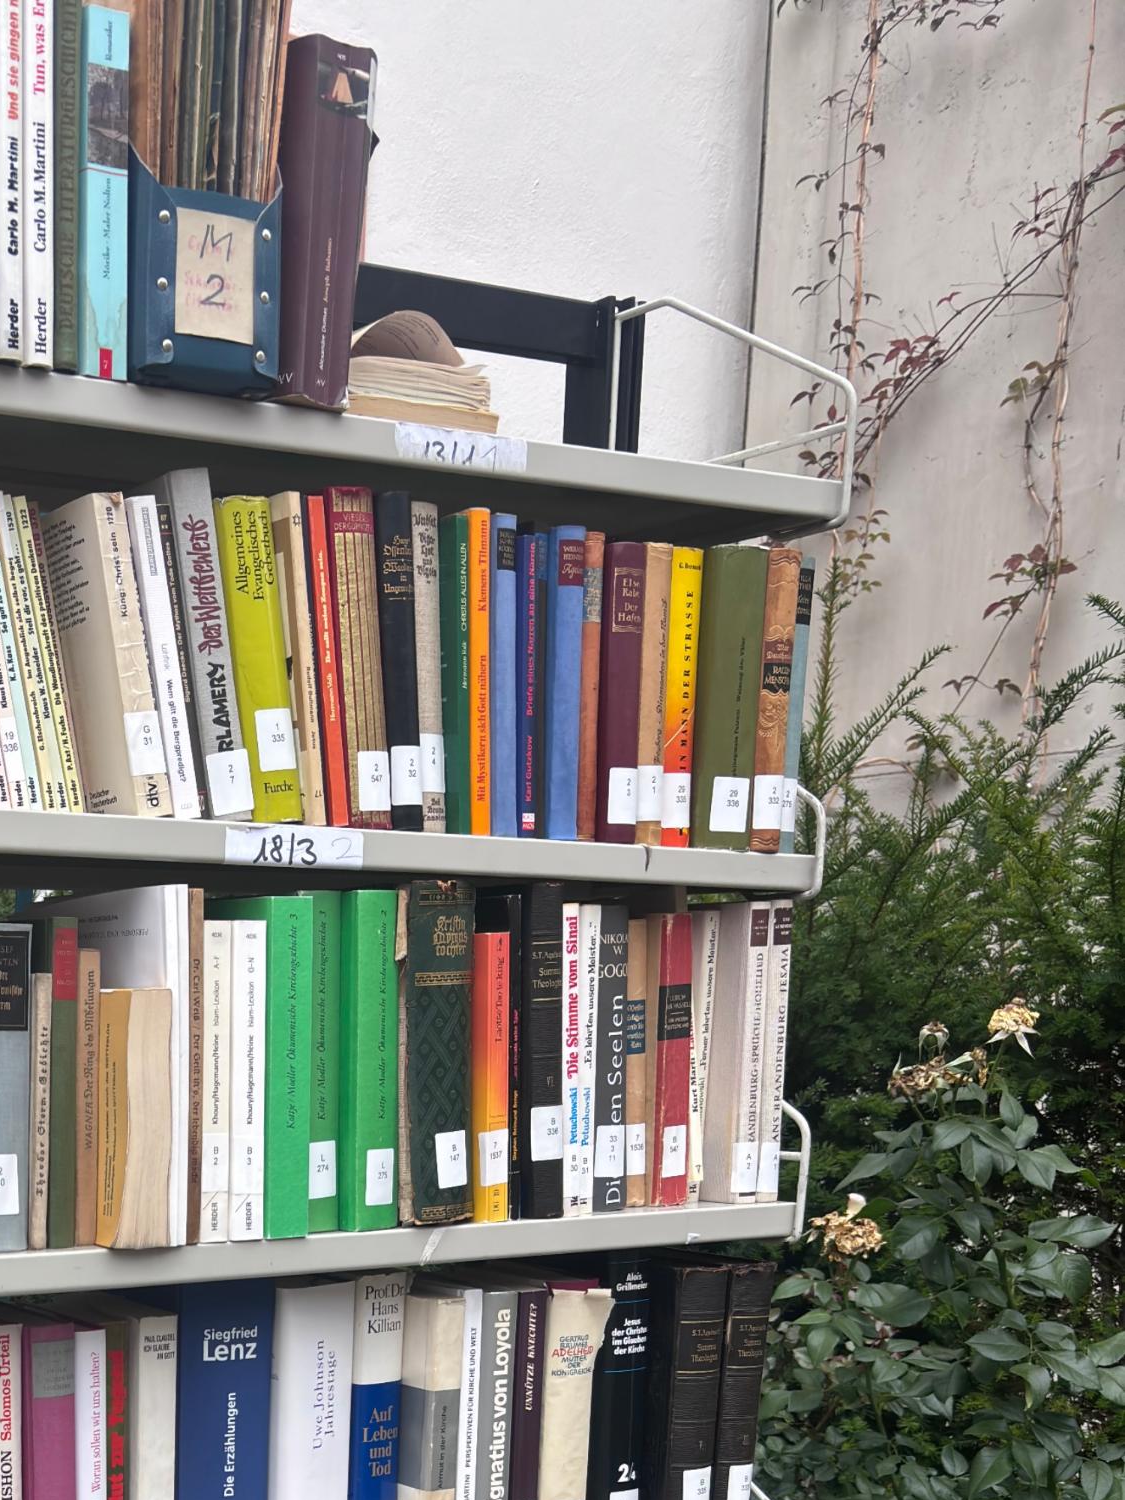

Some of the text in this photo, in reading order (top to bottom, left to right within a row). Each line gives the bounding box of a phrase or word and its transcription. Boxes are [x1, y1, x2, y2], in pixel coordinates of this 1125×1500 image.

[33, 24, 47, 354] Herder Carlo M. Martini Tun, was
[200, 275, 227, 308] 2
[231, 511, 249, 594] Allgemeines
[246, 511, 264, 600] Evangelisches
[259, 510, 275, 585] Gebetbuch
[477, 520, 488, 801] Mit Mystikern sich Gott nähern Klemens Tilmann
[680, 591, 694, 746] MANN DER STRASSE
[146, 783, 160, 807] dtv
[566, 916, 579, 1144] Petuchowski Die Stimme vom Sinai
[608, 994, 623, 1085] Seelen
[203, 1326, 258, 1341] Siegfried
[367, 1320, 401, 1334] Killian
[371, 1303, 399, 1316] Hans
[202, 1342, 258, 1362] Lenz
[494, 1309, 511, 1375] Loyola
[0, 1379, 12, 1441] Salomos
[312, 1340, 326, 1449] Uwe Johnson
[325, 1350, 337, 1437] Jahrestage
[370, 1405, 394, 1422] Auf
[492, 1379, 507, 1417] von
[223, 1392, 237, 1497] Die Erzählungen
[363, 1427, 398, 1442] Leben
[369, 1441, 392, 1459] und
[370, 1460, 391, 1478] Tod
